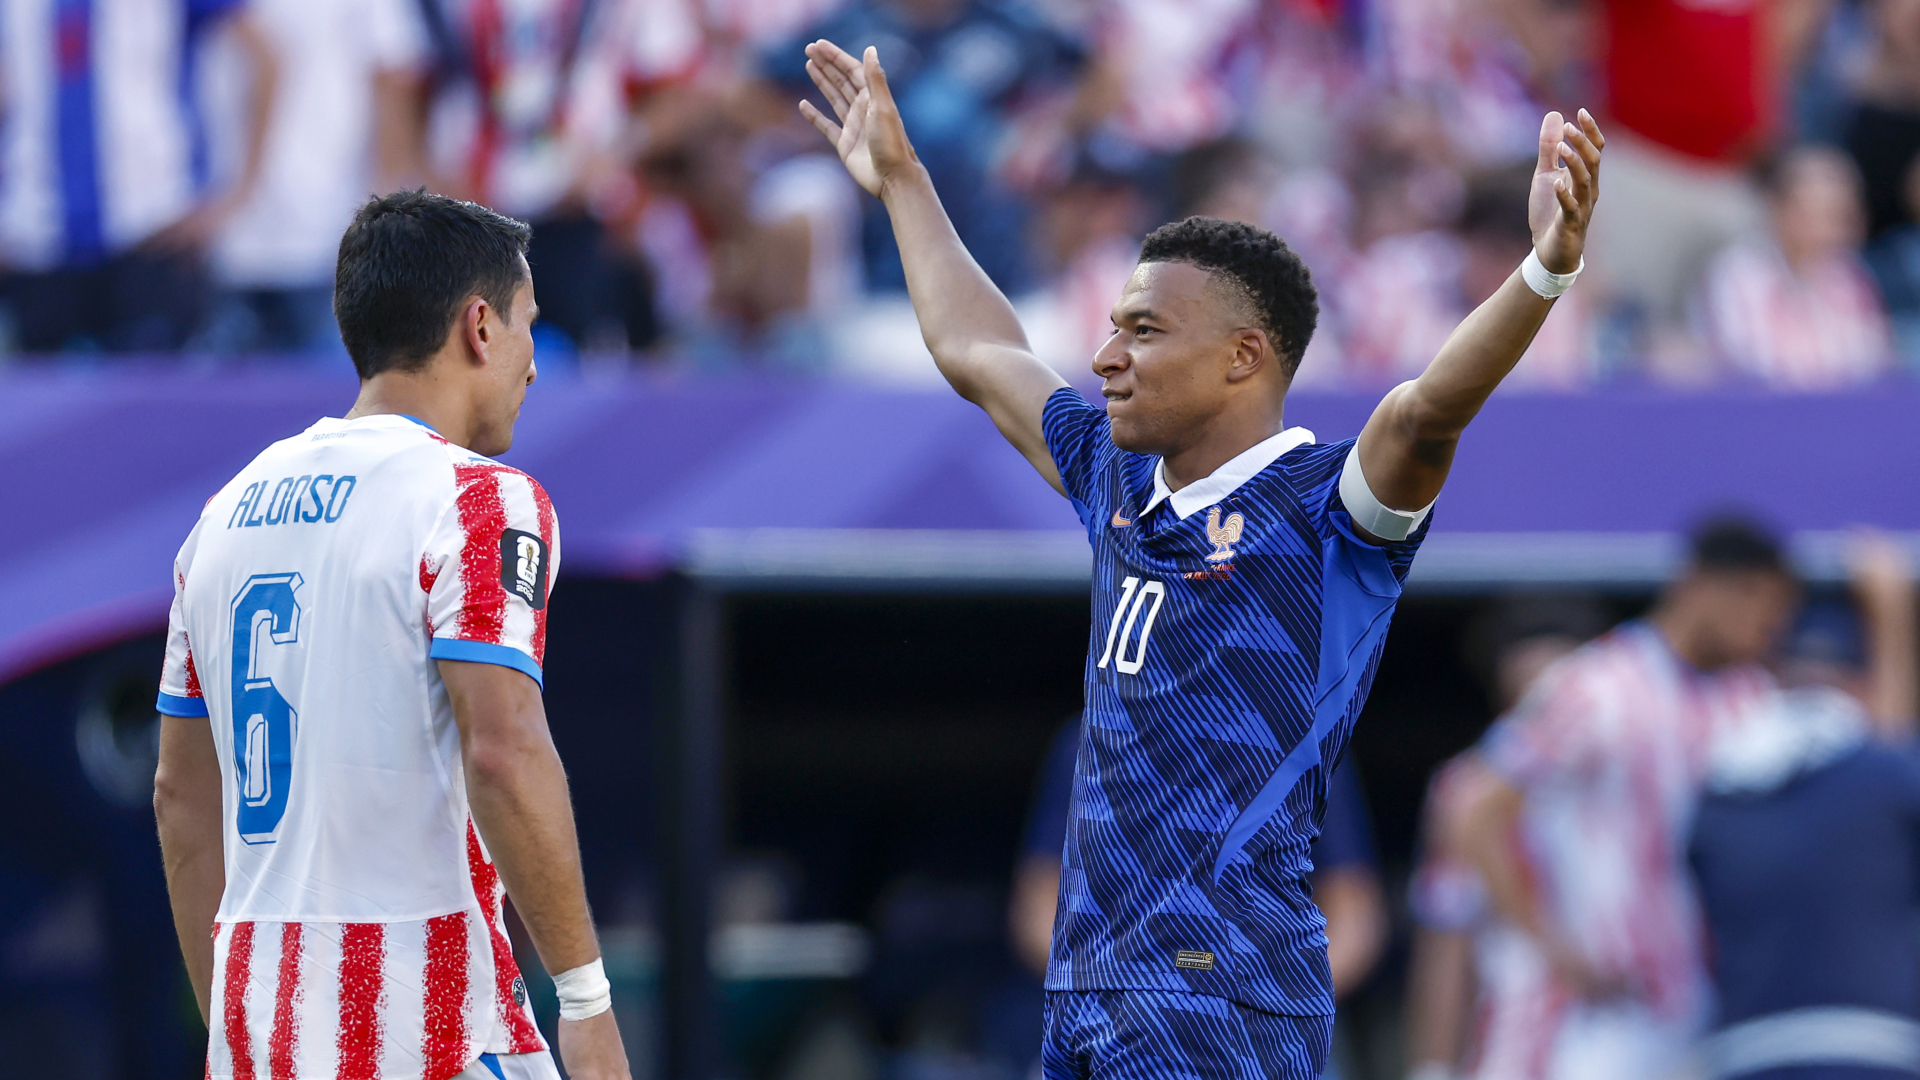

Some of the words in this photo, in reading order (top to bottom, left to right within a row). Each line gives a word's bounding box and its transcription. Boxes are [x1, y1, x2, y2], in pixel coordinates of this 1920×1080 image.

[227, 474, 357, 530] ALONSO
[1097, 576, 1165, 675] 10
[230, 572, 304, 845] 6
